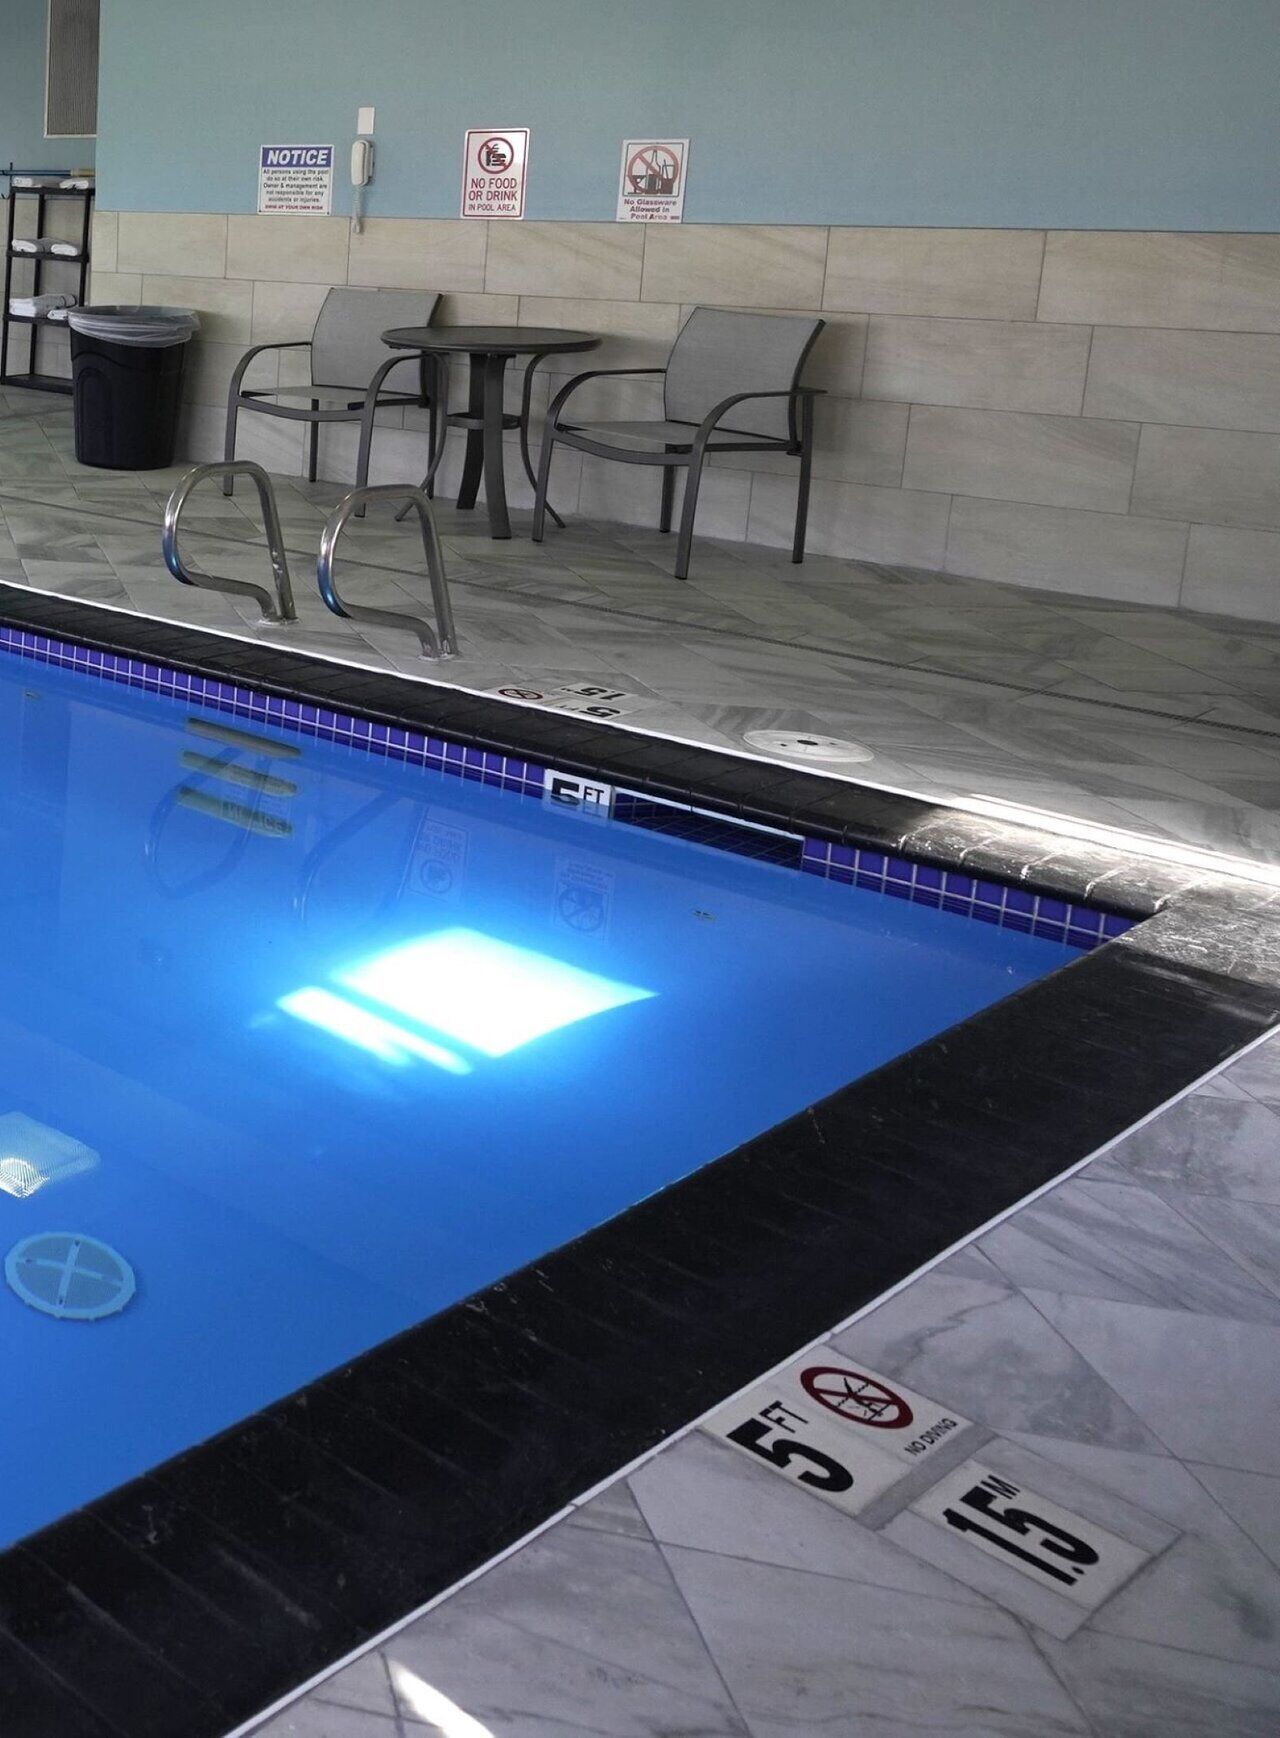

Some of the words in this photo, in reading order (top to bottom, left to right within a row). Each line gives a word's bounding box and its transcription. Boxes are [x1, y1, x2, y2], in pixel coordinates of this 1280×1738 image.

[267, 149, 329, 165] NOTICE
[468, 190, 483, 201] OR
[486, 190, 518, 201] DRINK
[471, 177, 486, 189] NO
[488, 177, 517, 189] FOOD
[468, 203, 476, 211] IN
[477, 203, 495, 212] POOL
[496, 203, 516, 212] AREA
[578, 706, 621, 718] 5
[551, 777, 580, 804] 5
[583, 785, 605, 804] FT
[759, 1400, 809, 1433] FT
[904, 1441, 927, 1457] NO
[919, 1418, 958, 1445] DIVING
[726, 1418, 854, 1492] 5
[981, 1474, 1021, 1500] M
[942, 1485, 1100, 1587] 1.5
